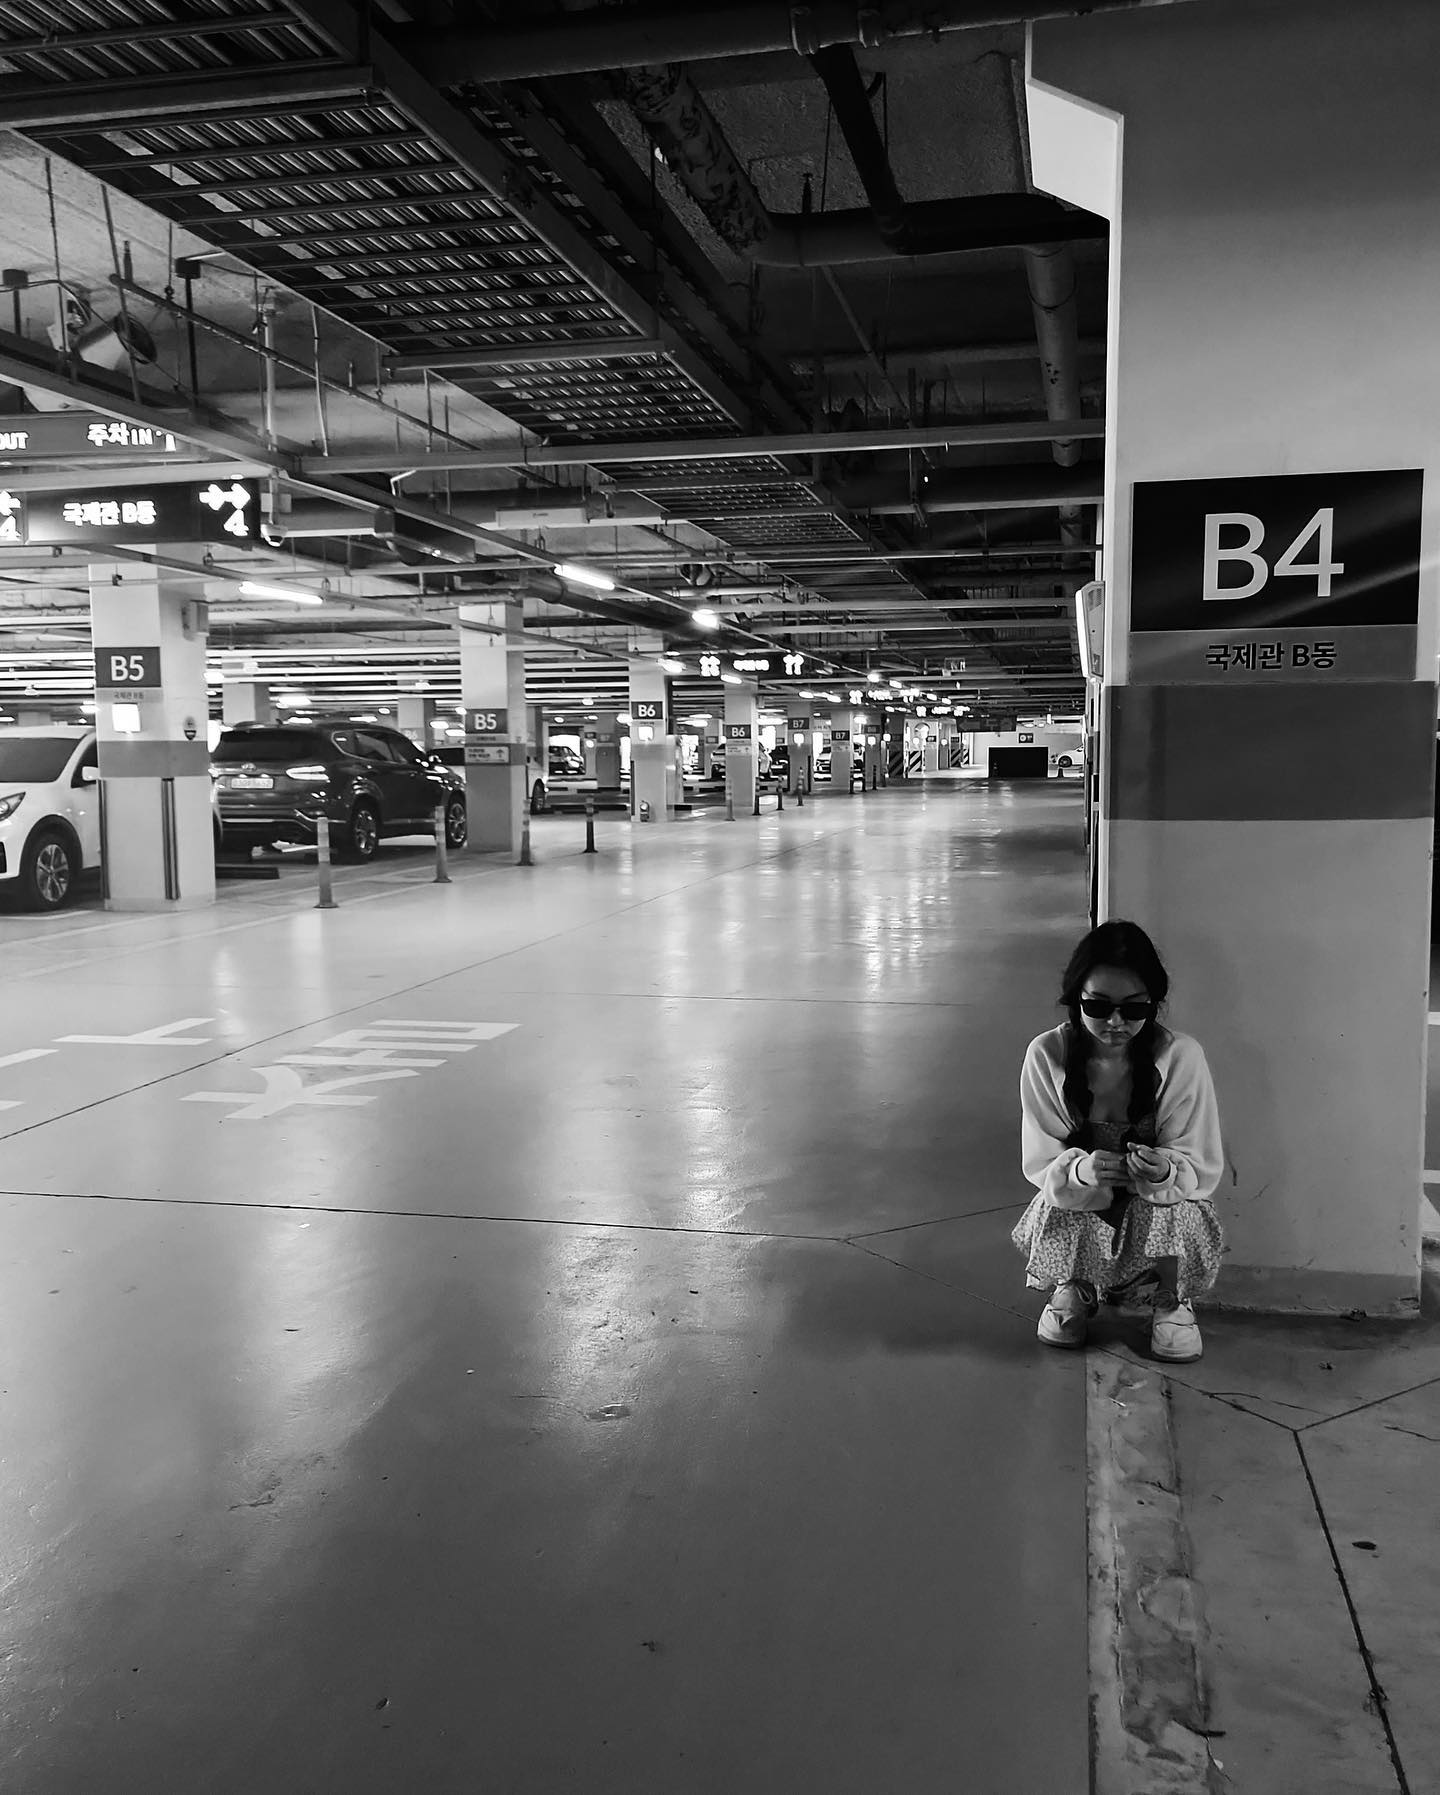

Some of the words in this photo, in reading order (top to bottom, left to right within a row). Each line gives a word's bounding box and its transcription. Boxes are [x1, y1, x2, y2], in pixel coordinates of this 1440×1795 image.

[1202, 507, 1344, 601] B4
[1206, 643, 1285, 671] 국제관
[1291, 641, 1338, 668] B동
[110, 655, 144, 681] B5
[637, 704, 656, 717] B6
[474, 713, 497, 730] B5
[793, 720, 805, 729] B7
[731, 727, 746, 737] B6
[835, 732, 846, 740] B7
